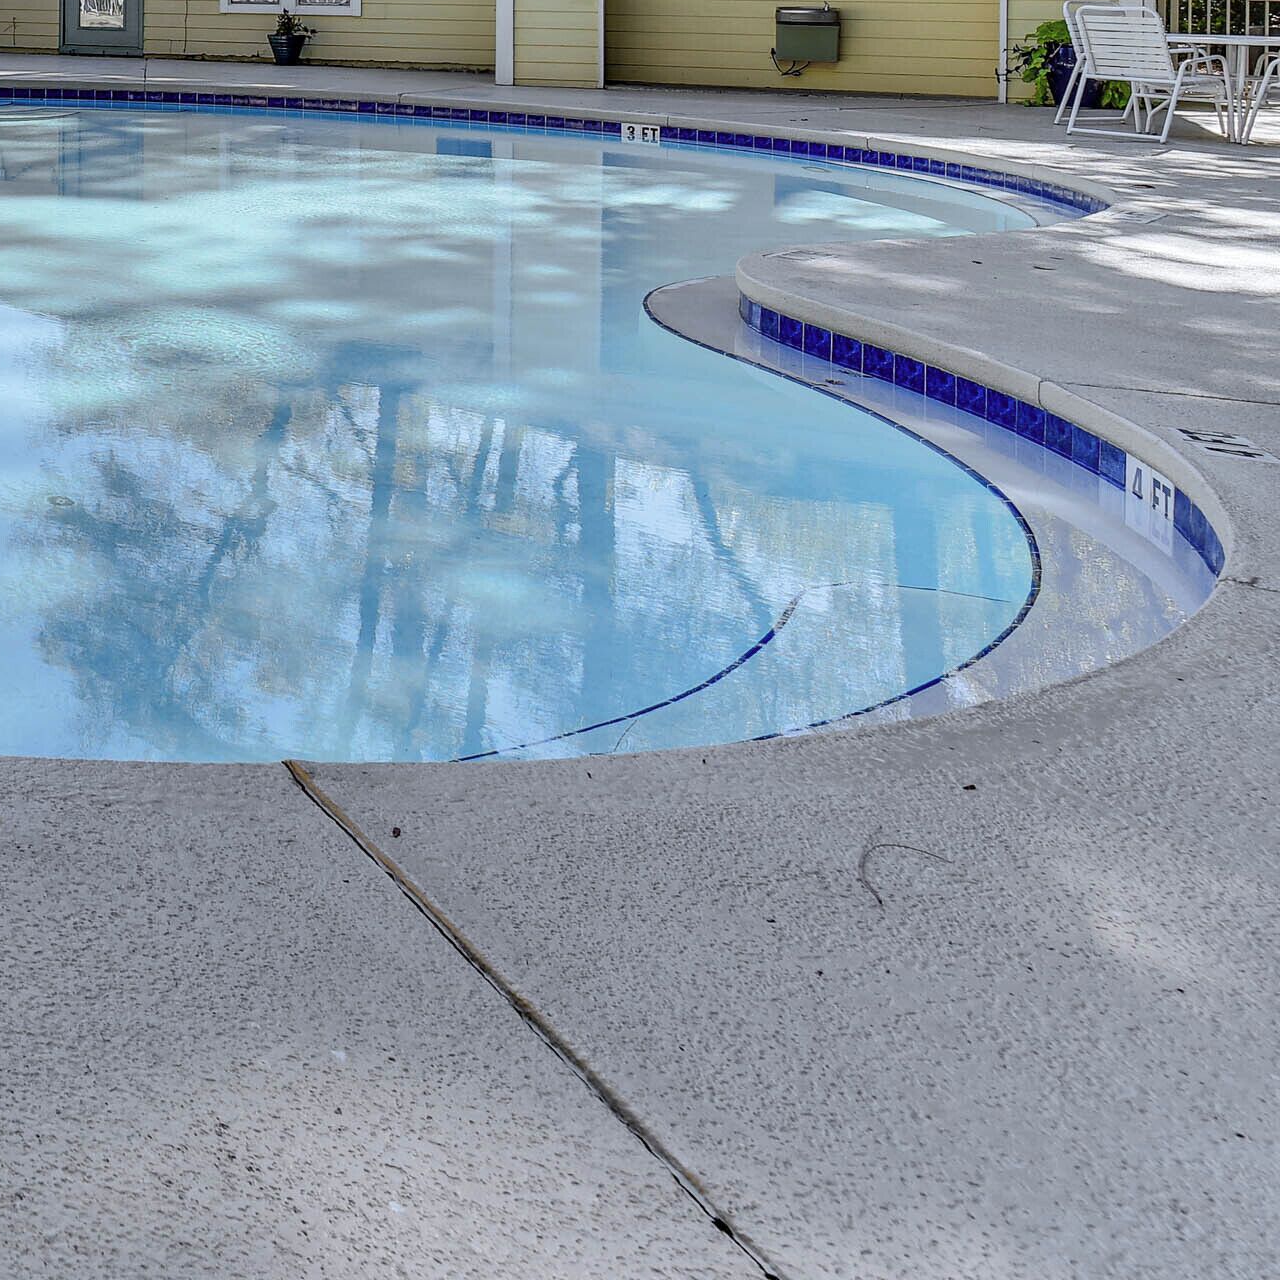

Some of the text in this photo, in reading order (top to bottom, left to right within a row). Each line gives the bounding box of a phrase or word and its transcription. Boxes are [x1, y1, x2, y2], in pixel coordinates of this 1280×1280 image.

[627, 126, 658, 142] 3 FT
[1132, 467, 1171, 519] 4 FT
